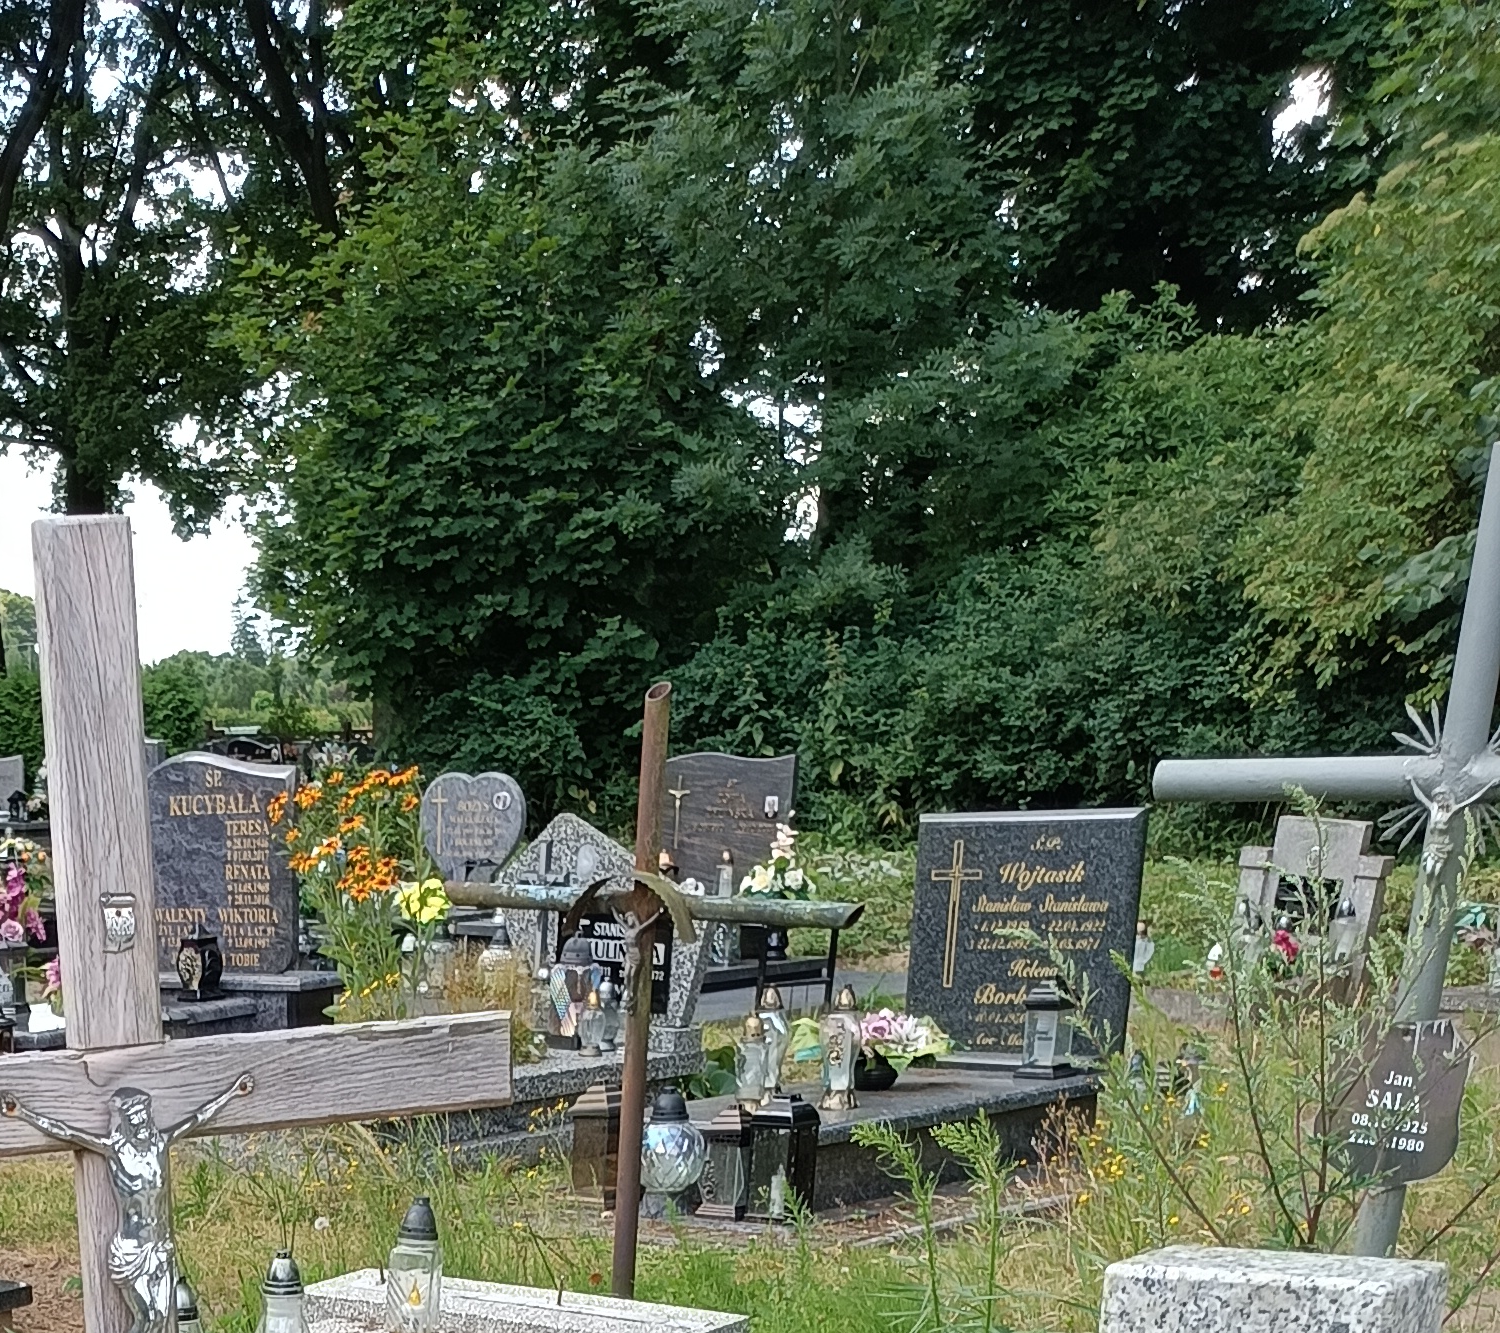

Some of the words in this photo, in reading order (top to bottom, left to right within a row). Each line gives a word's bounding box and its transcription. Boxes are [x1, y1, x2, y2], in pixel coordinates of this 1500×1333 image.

[225, 820, 270, 836] TERESA
[225, 864, 270, 880] RENATA
[999, 861, 1086, 892] Wojtasik
[155, 908, 206, 923] WALENTY
[218, 908, 278, 923] WIKTORIA
[230, 953, 260, 966] TOBIE
[1384, 1071, 1413, 1088] Jan
